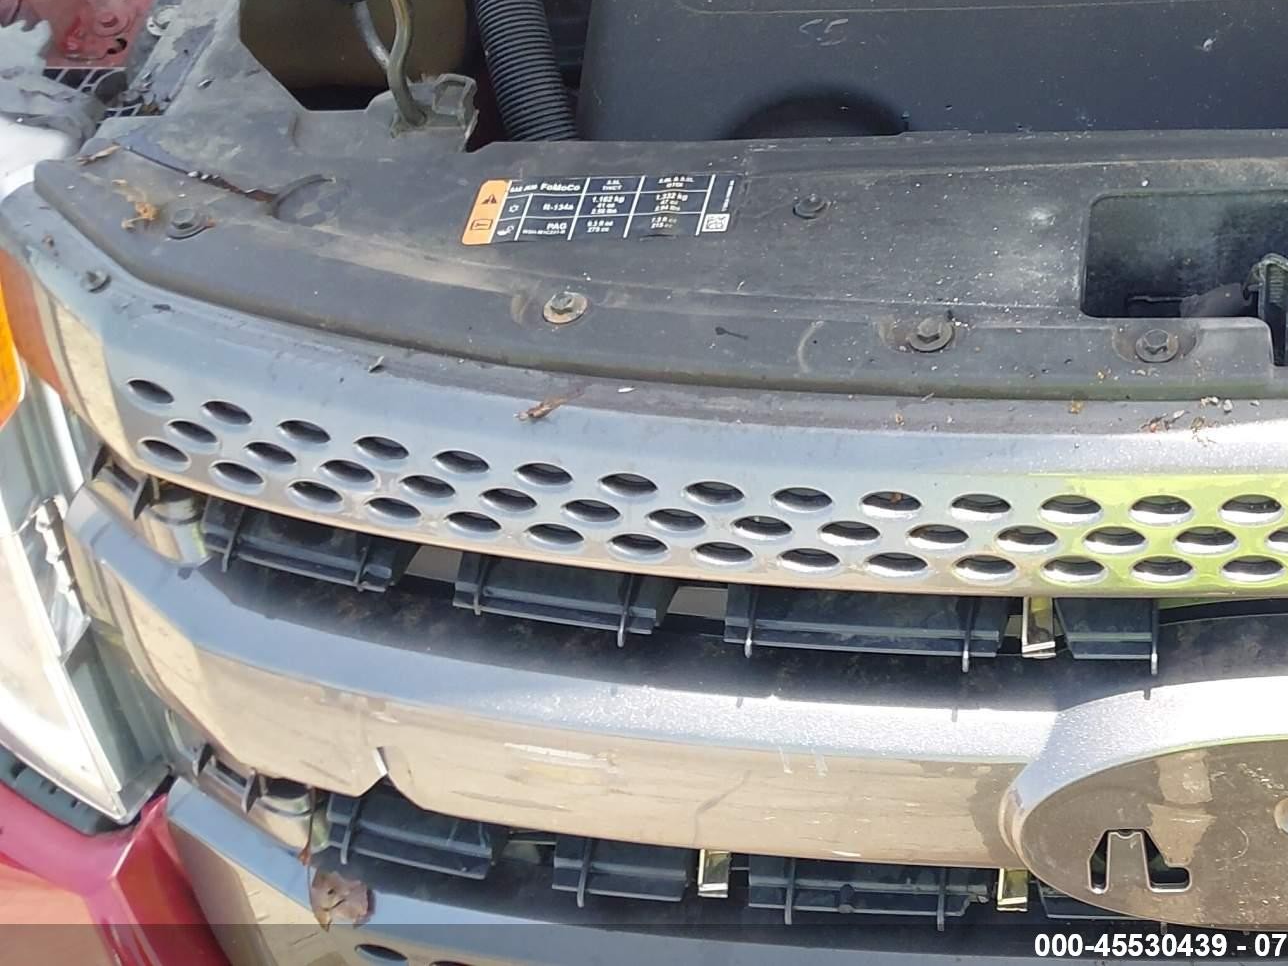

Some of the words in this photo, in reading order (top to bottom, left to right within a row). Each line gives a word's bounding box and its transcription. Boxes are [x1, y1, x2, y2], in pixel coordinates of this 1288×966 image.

[540, 183, 581, 192] FoMoCo
[614, 195, 625, 204] kg
[677, 193, 688, 202] kg
[546, 222, 567, 230] PAG
